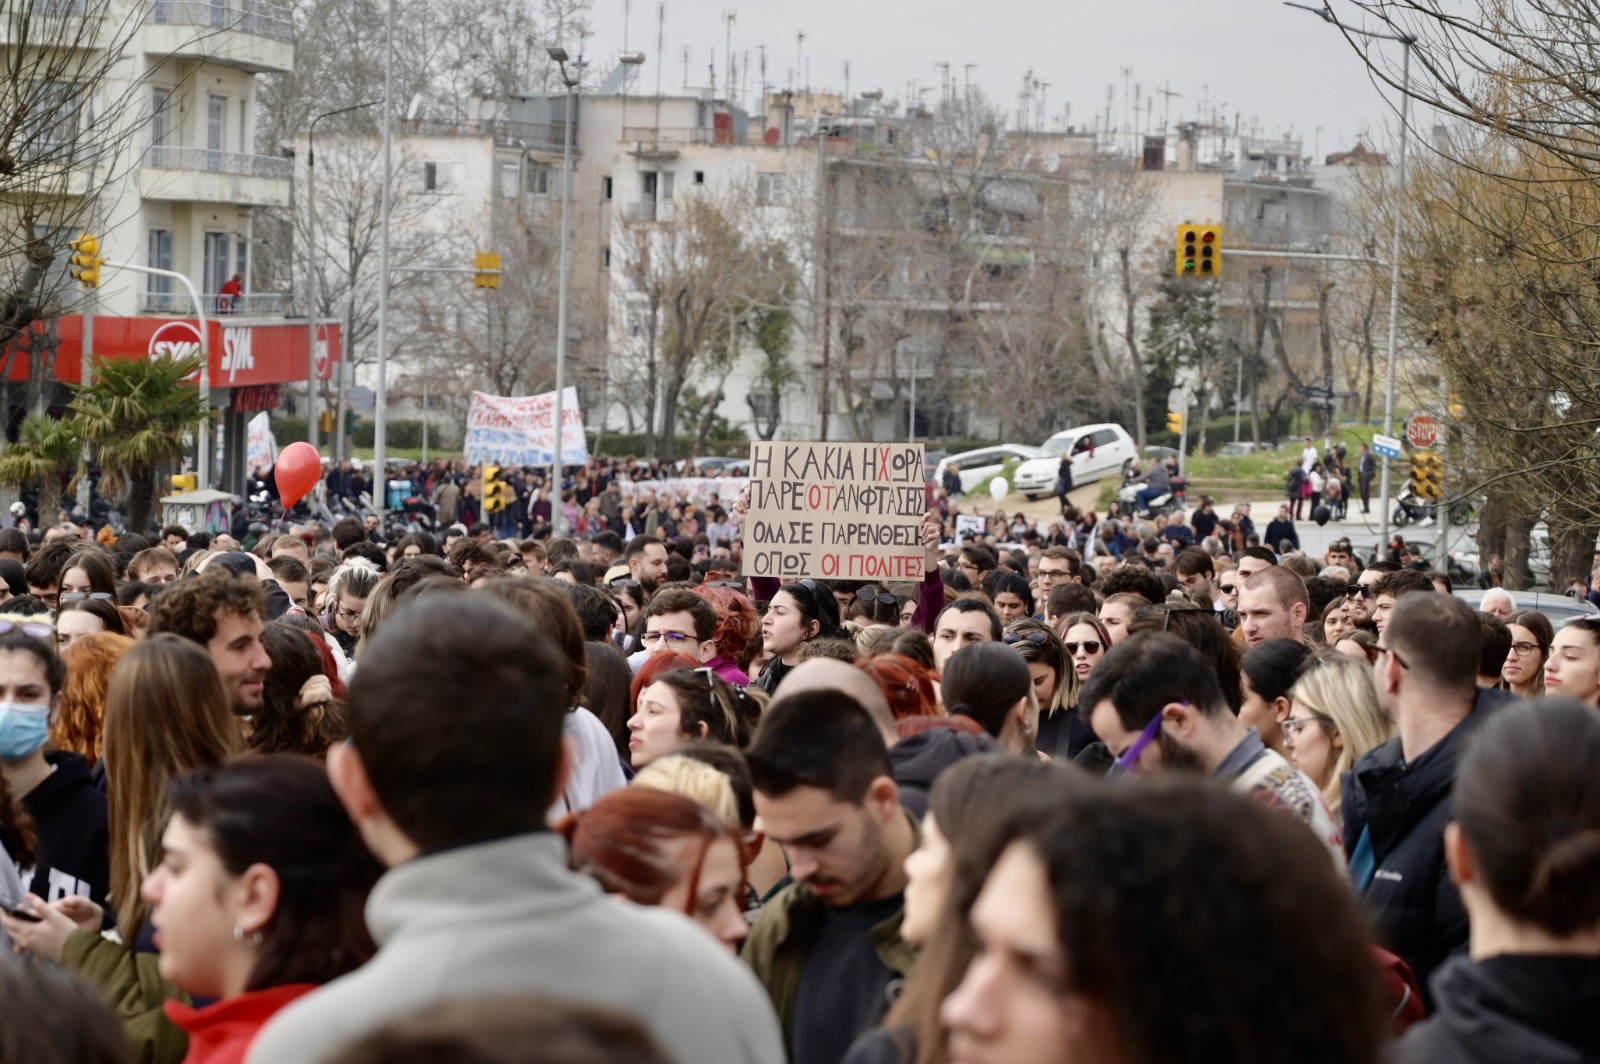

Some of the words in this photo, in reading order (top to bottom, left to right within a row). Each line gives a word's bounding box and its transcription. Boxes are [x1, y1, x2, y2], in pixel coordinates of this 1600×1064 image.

[1410, 422, 1436, 440] STOP
[753, 446, 771, 477] Η
[784, 446, 854, 480] ΚΑΚΙΑ
[822, 554, 839, 576] ΟΙ
[849, 555, 924, 577] ΠΟΛΙΤΕΣ
